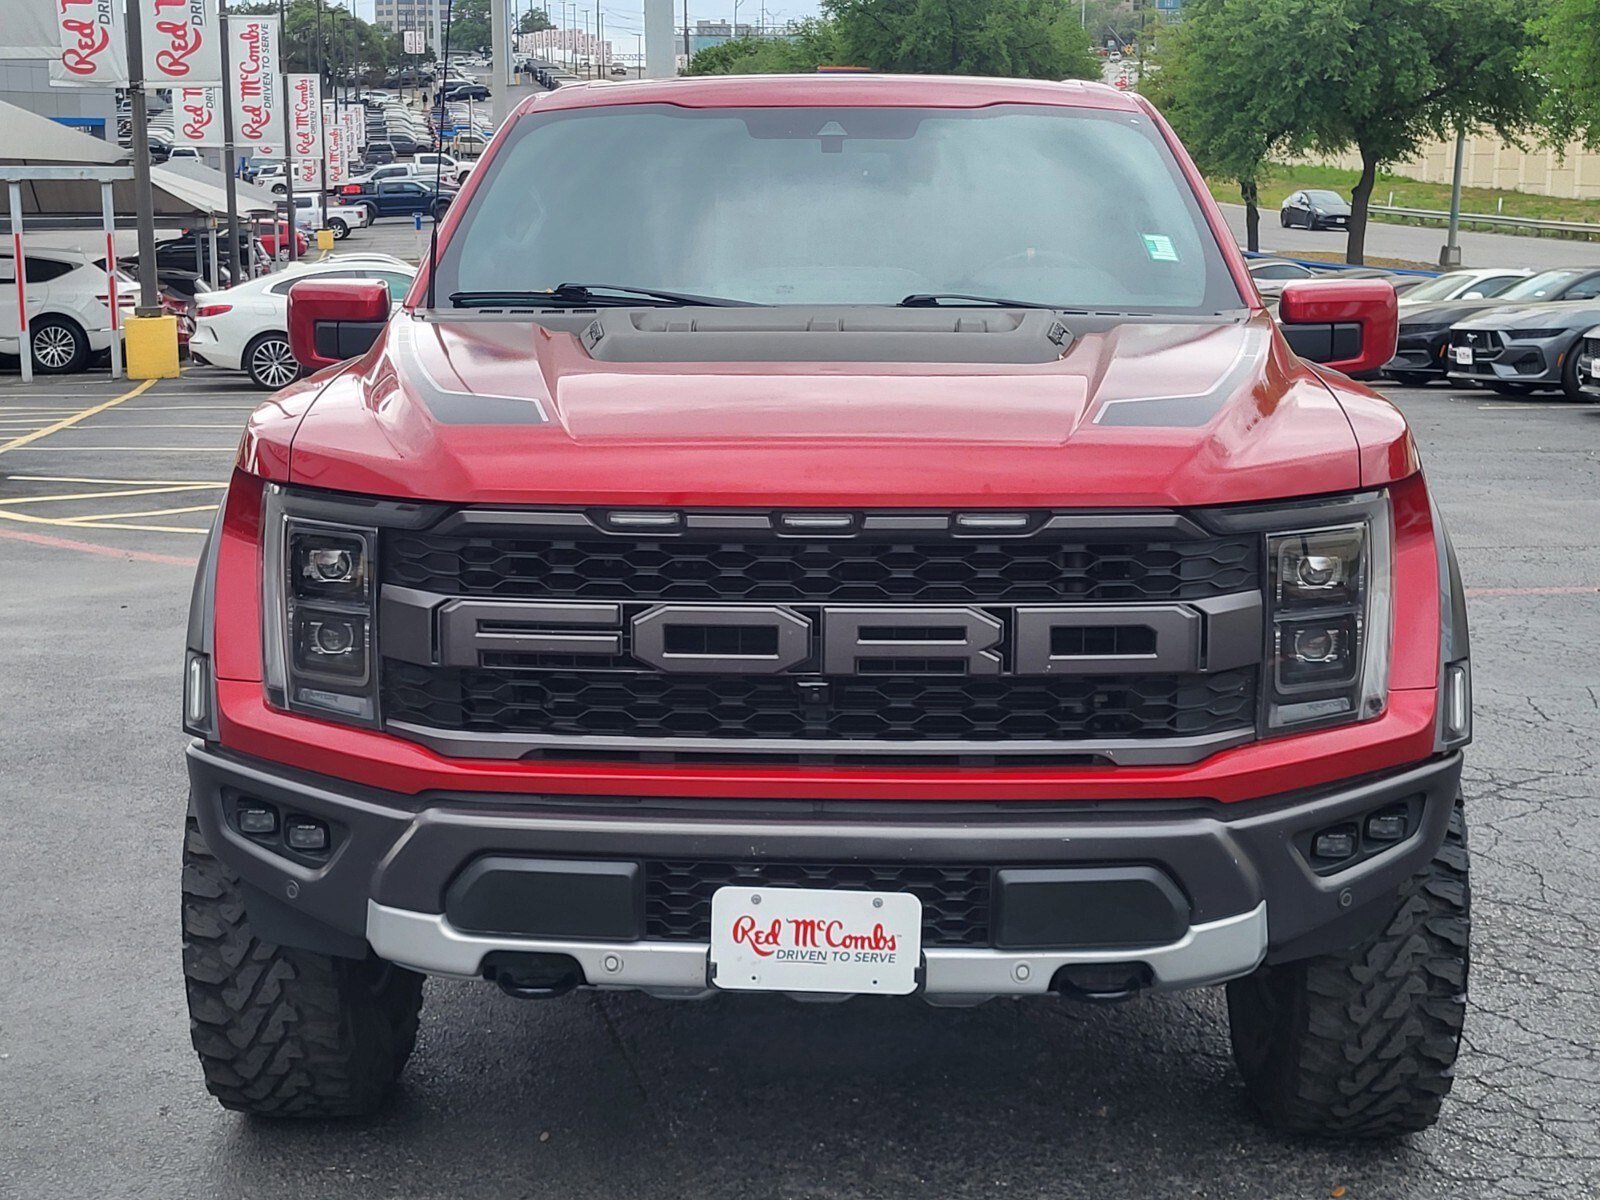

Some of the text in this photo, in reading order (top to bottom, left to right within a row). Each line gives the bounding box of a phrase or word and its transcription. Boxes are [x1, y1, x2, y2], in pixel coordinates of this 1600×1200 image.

[62, 19, 110, 75] Red
[155, 21, 203, 76] Red
[239, 23, 262, 102] McCombs
[261, 23, 272, 109] DRIVEN TO SERVE
[182, 105, 212, 139] Red
[241, 105, 271, 139] Red
[294, 79, 310, 130] McCombs
[296, 132, 315, 154] Red
[437, 599, 1201, 675] FORD
[732, 915, 896, 957] Red McCombs
[776, 949, 896, 964] DRIVEN TO SERVE
